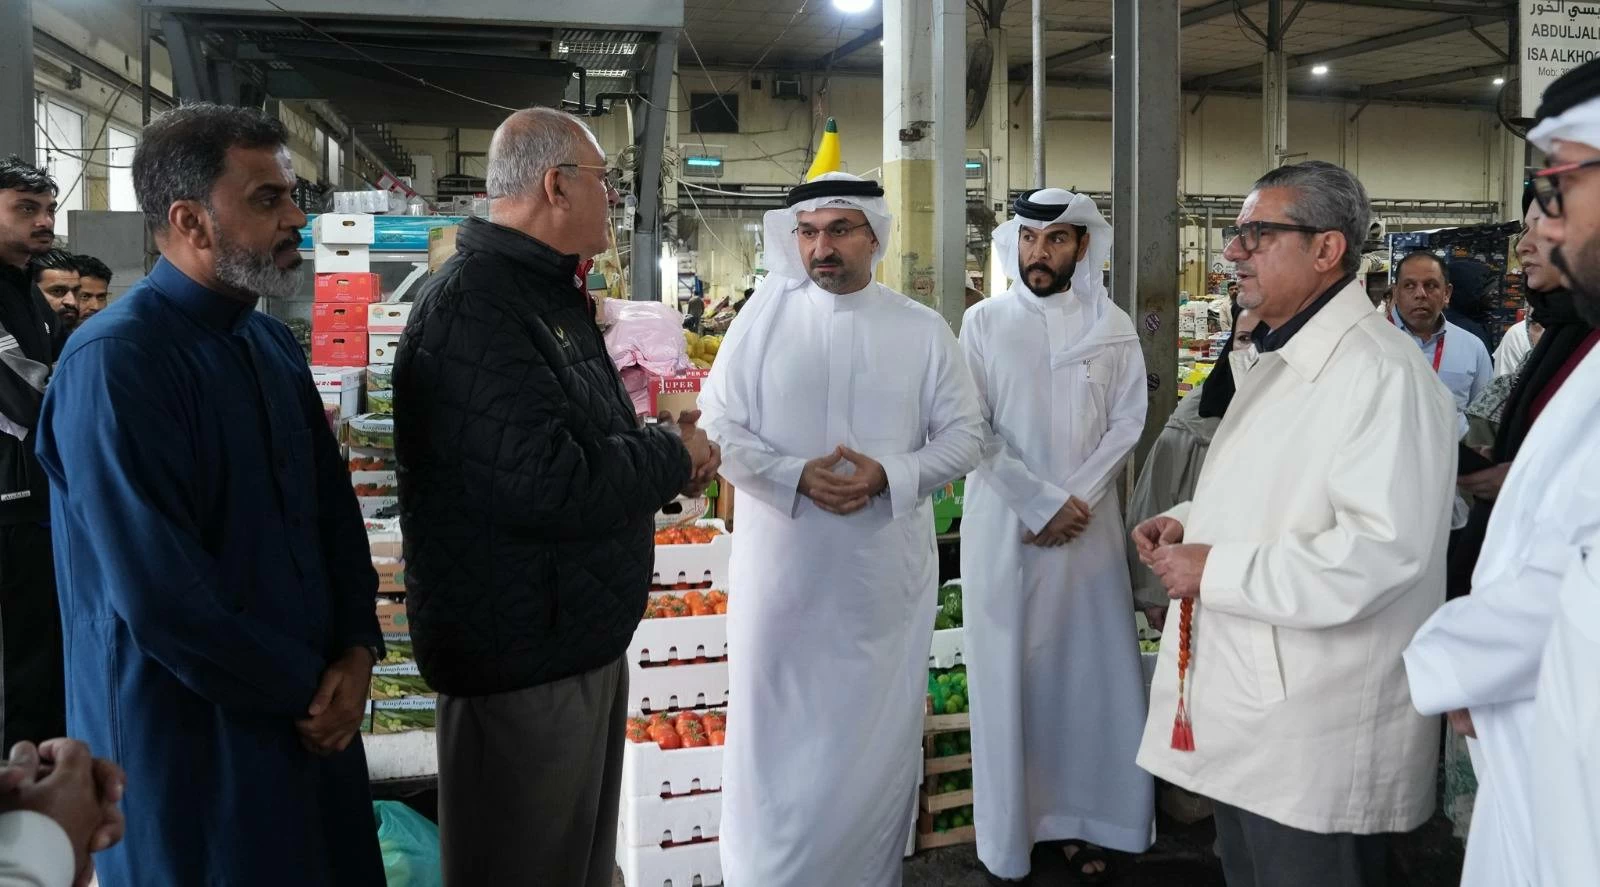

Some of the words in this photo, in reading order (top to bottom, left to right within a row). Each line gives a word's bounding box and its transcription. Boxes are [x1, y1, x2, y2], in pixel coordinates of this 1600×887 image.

[1527, 47, 1548, 61] ISA
[1538, 66, 1558, 77] Mob:
[658, 381, 694, 389] SUPER
